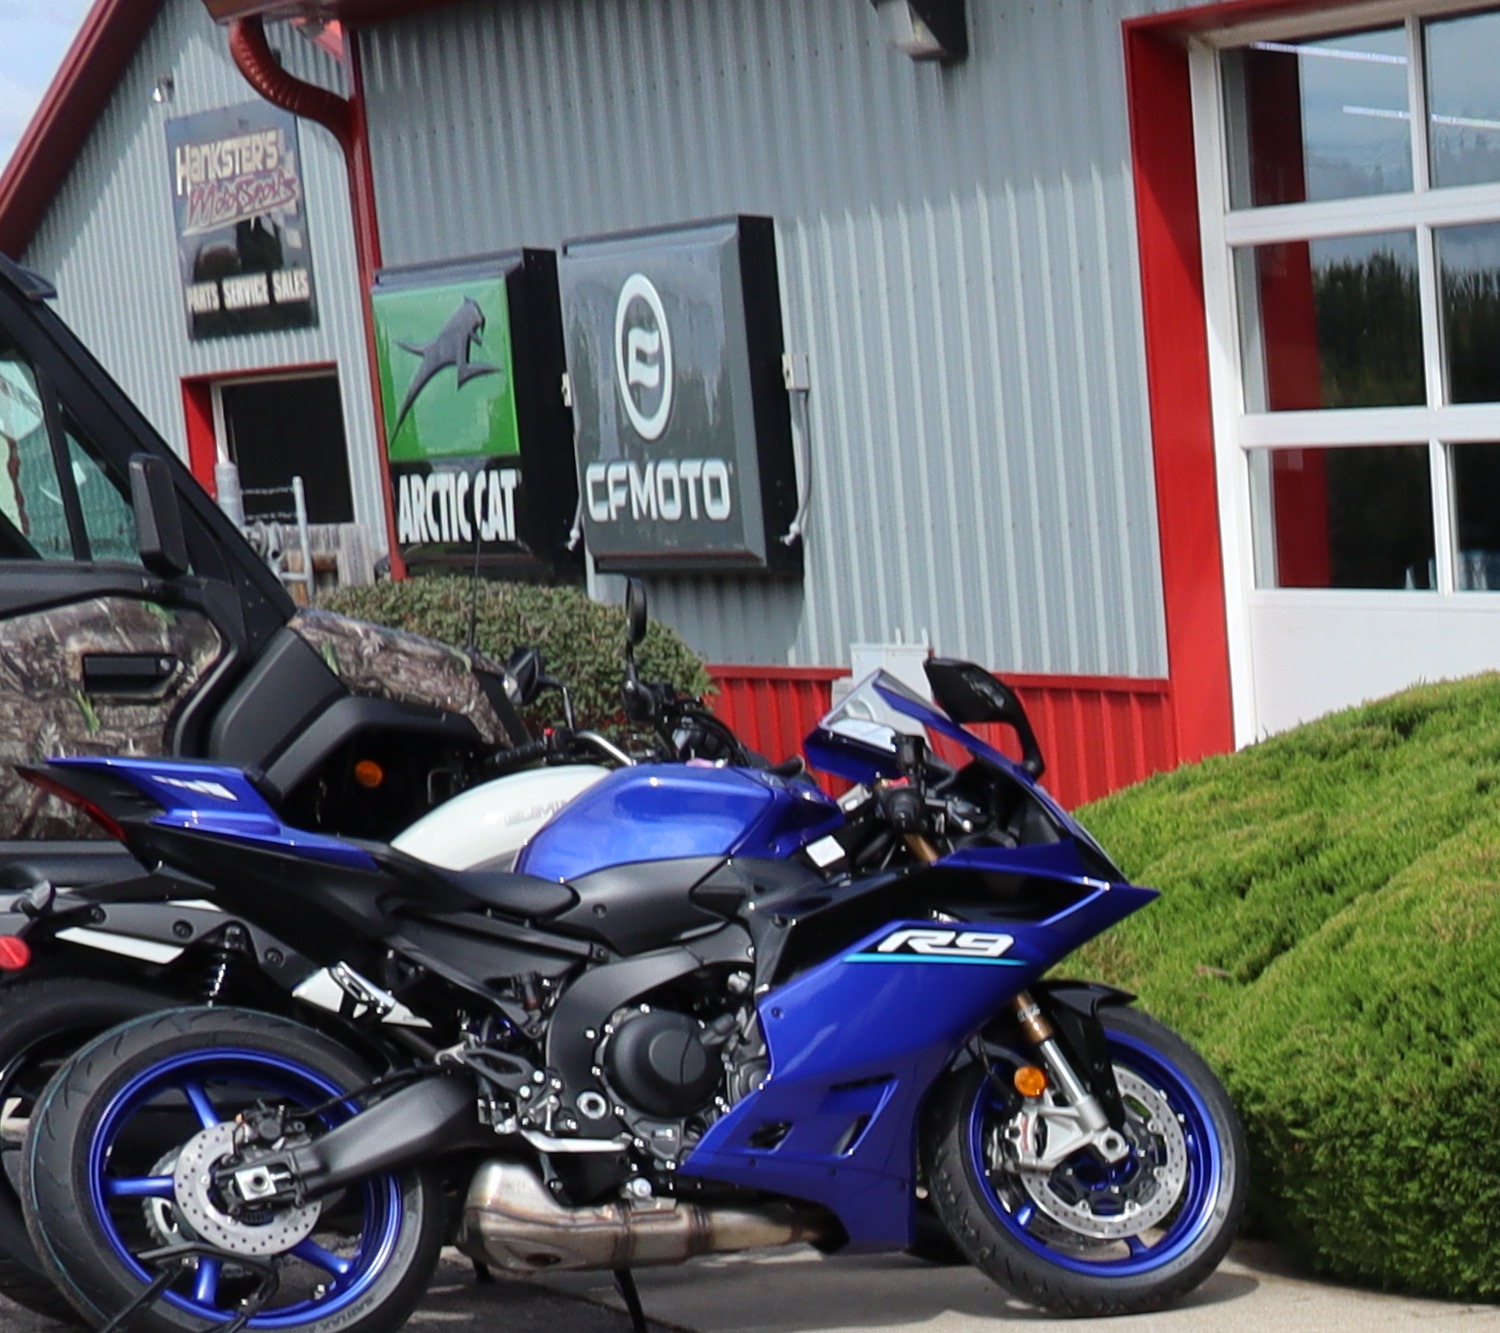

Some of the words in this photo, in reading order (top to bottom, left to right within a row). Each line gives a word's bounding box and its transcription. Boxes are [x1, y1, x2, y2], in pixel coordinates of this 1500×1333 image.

[186, 281, 221, 314] PARTS
[222, 272, 271, 310] SERVICE
[272, 268, 311, 304] SALES
[398, 472, 473, 544] ARCTIC
[473, 468, 518, 542] CAT
[586, 458, 731, 522] CFMOTO
[876, 928, 1015, 957] R9
